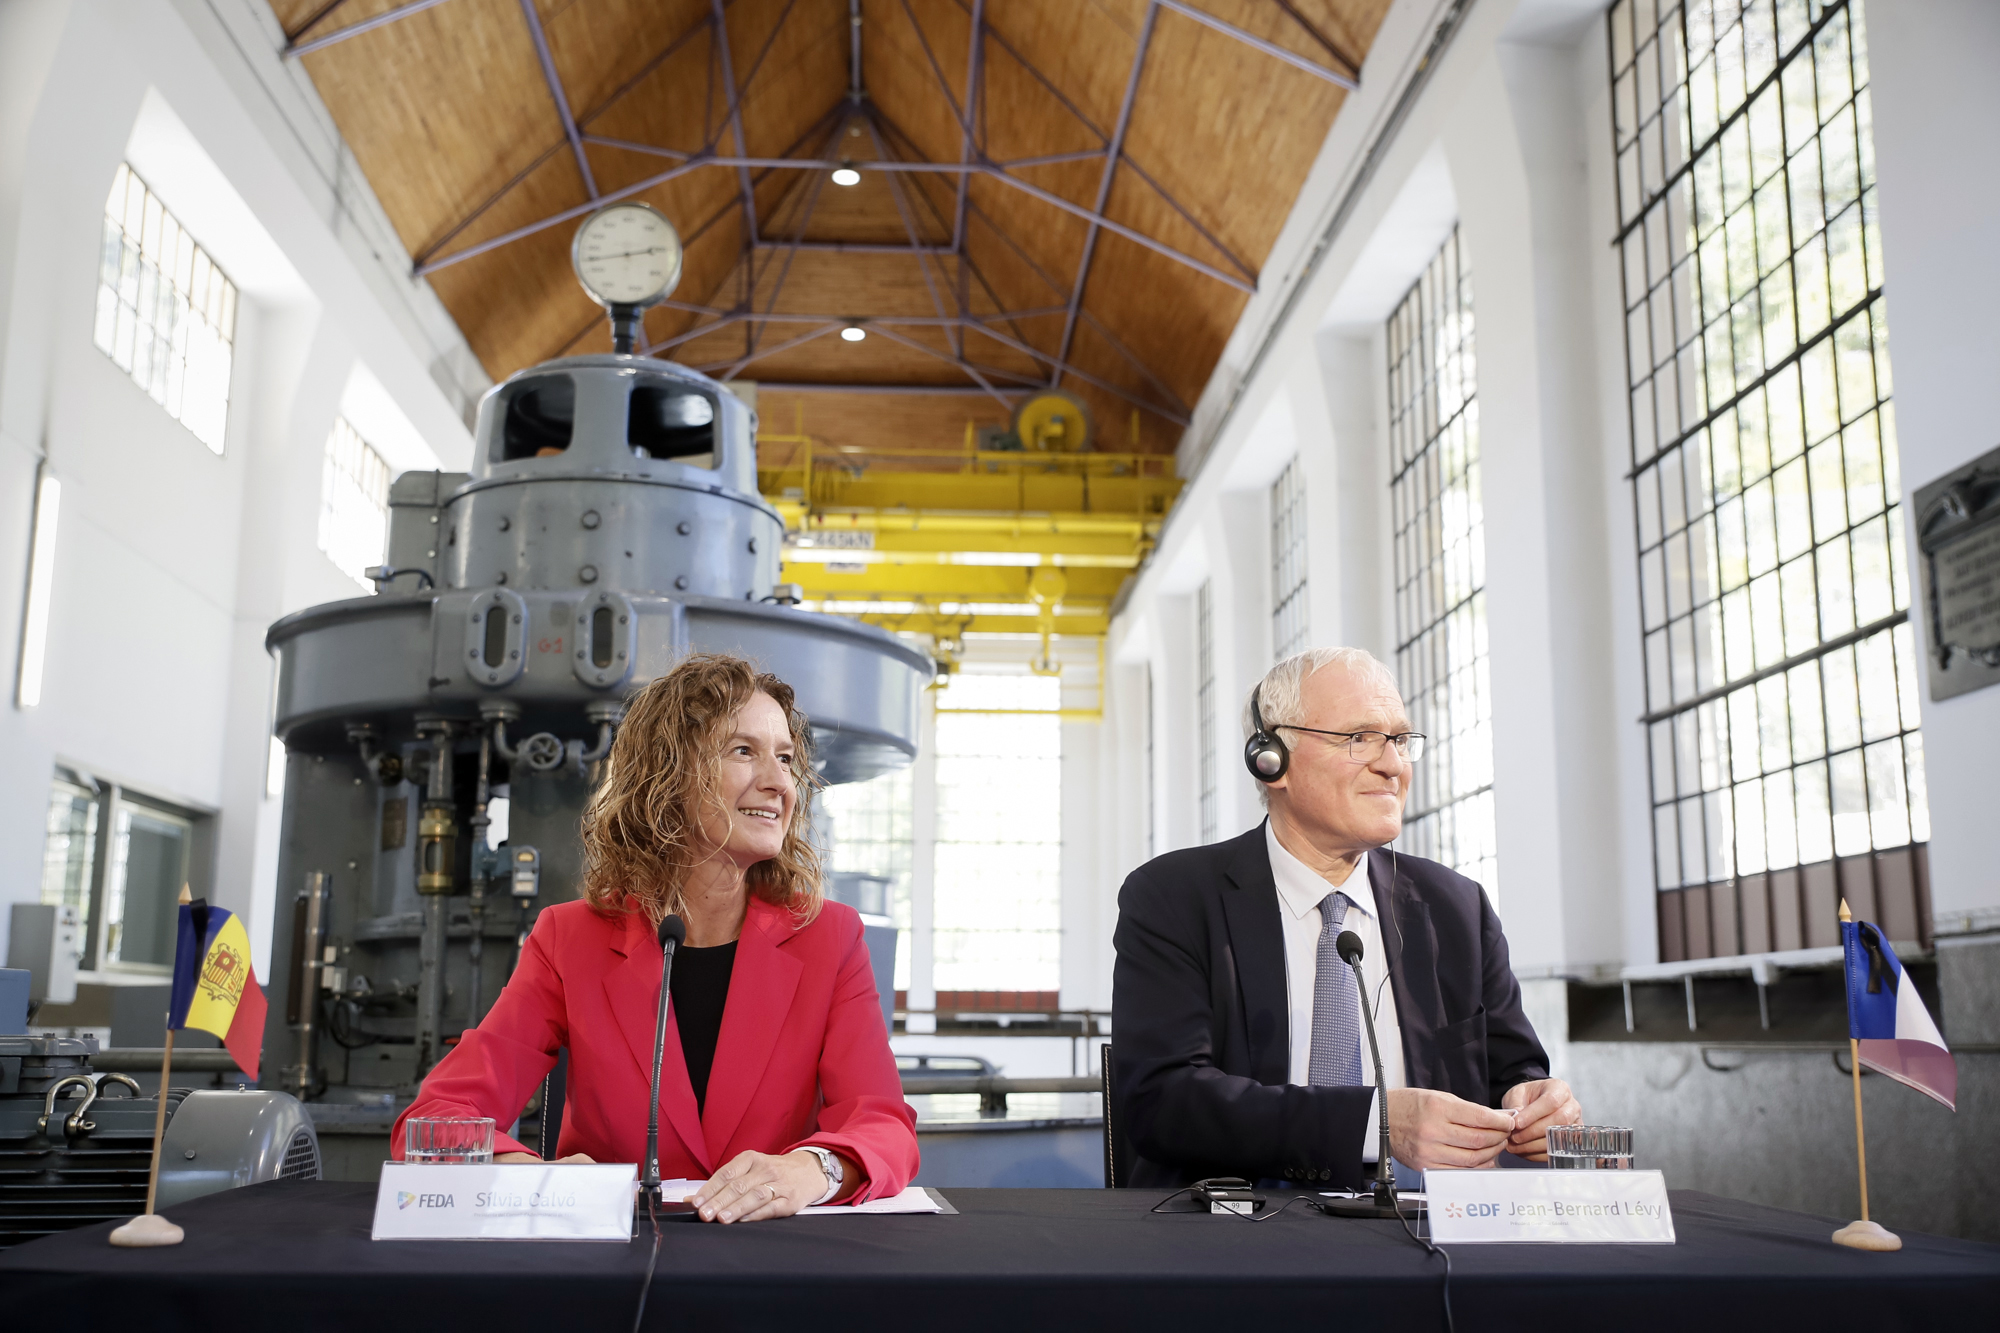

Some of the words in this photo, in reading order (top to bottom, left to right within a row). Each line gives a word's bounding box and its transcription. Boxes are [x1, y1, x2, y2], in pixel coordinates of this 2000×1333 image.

[537, 637, 564, 654] G1
[418, 1193, 455, 1208] FEDA
[475, 1191, 523, 1207] Sílvia
[529, 1191, 576, 1207] Calvó
[1508, 1201, 1620, 1216] Jean-Bernard
[1625, 1200, 1662, 1220] Lévy
